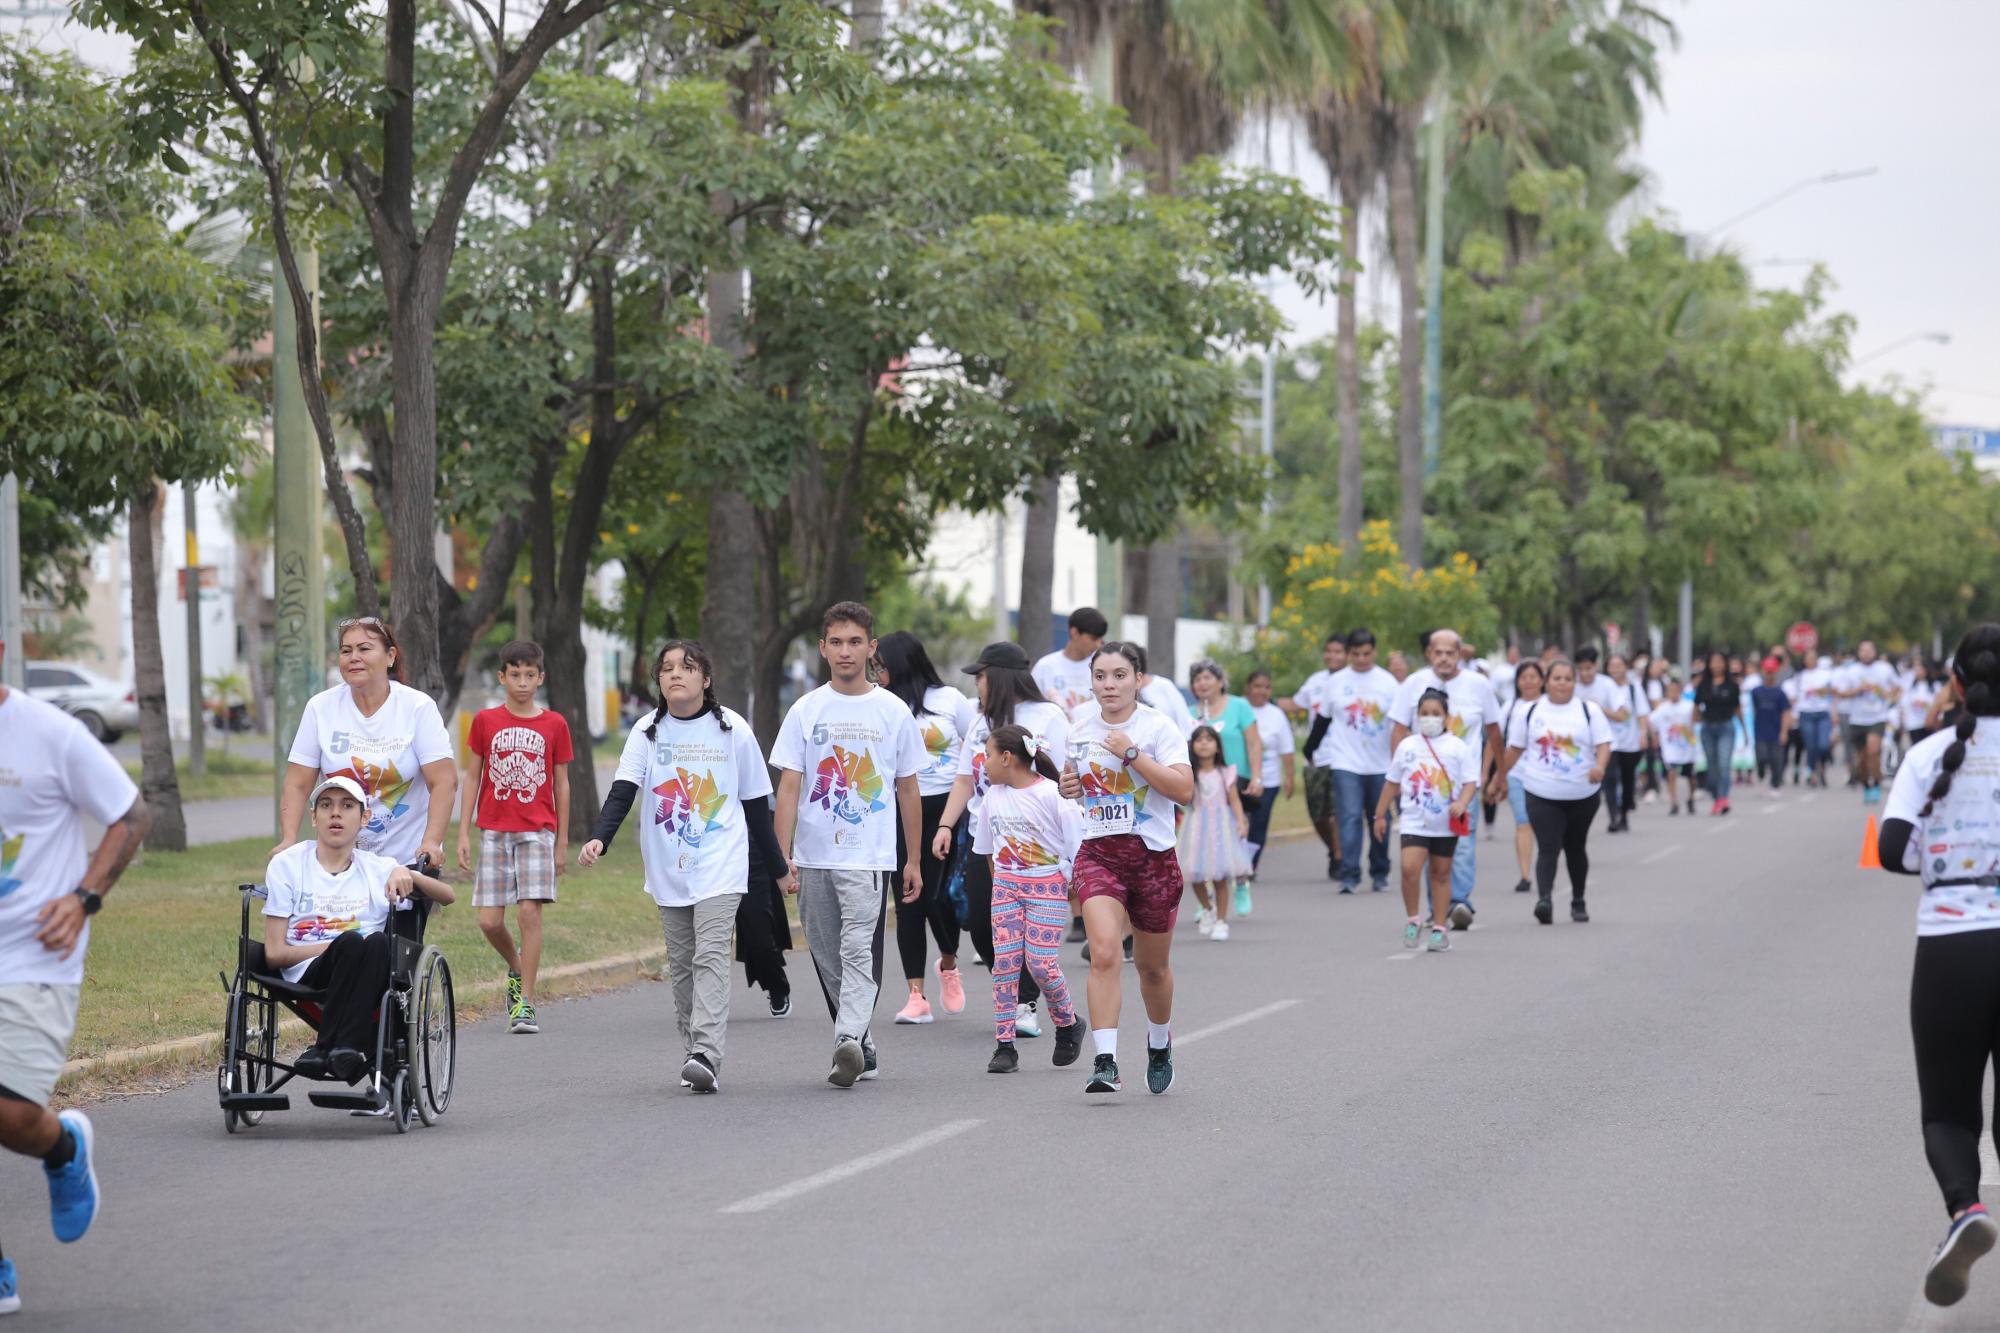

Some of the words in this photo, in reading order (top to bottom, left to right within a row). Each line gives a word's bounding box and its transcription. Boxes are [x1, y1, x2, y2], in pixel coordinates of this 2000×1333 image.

[329, 730, 350, 755] 5
[812, 723, 829, 746] 5
[829, 732, 857, 741] Parálisis
[858, 733, 884, 743] Cerebral
[657, 742, 673, 766] 5
[672, 753, 700, 762] Parálisis
[701, 753, 729, 762] Cerebral
[1099, 804, 1128, 822] 0021
